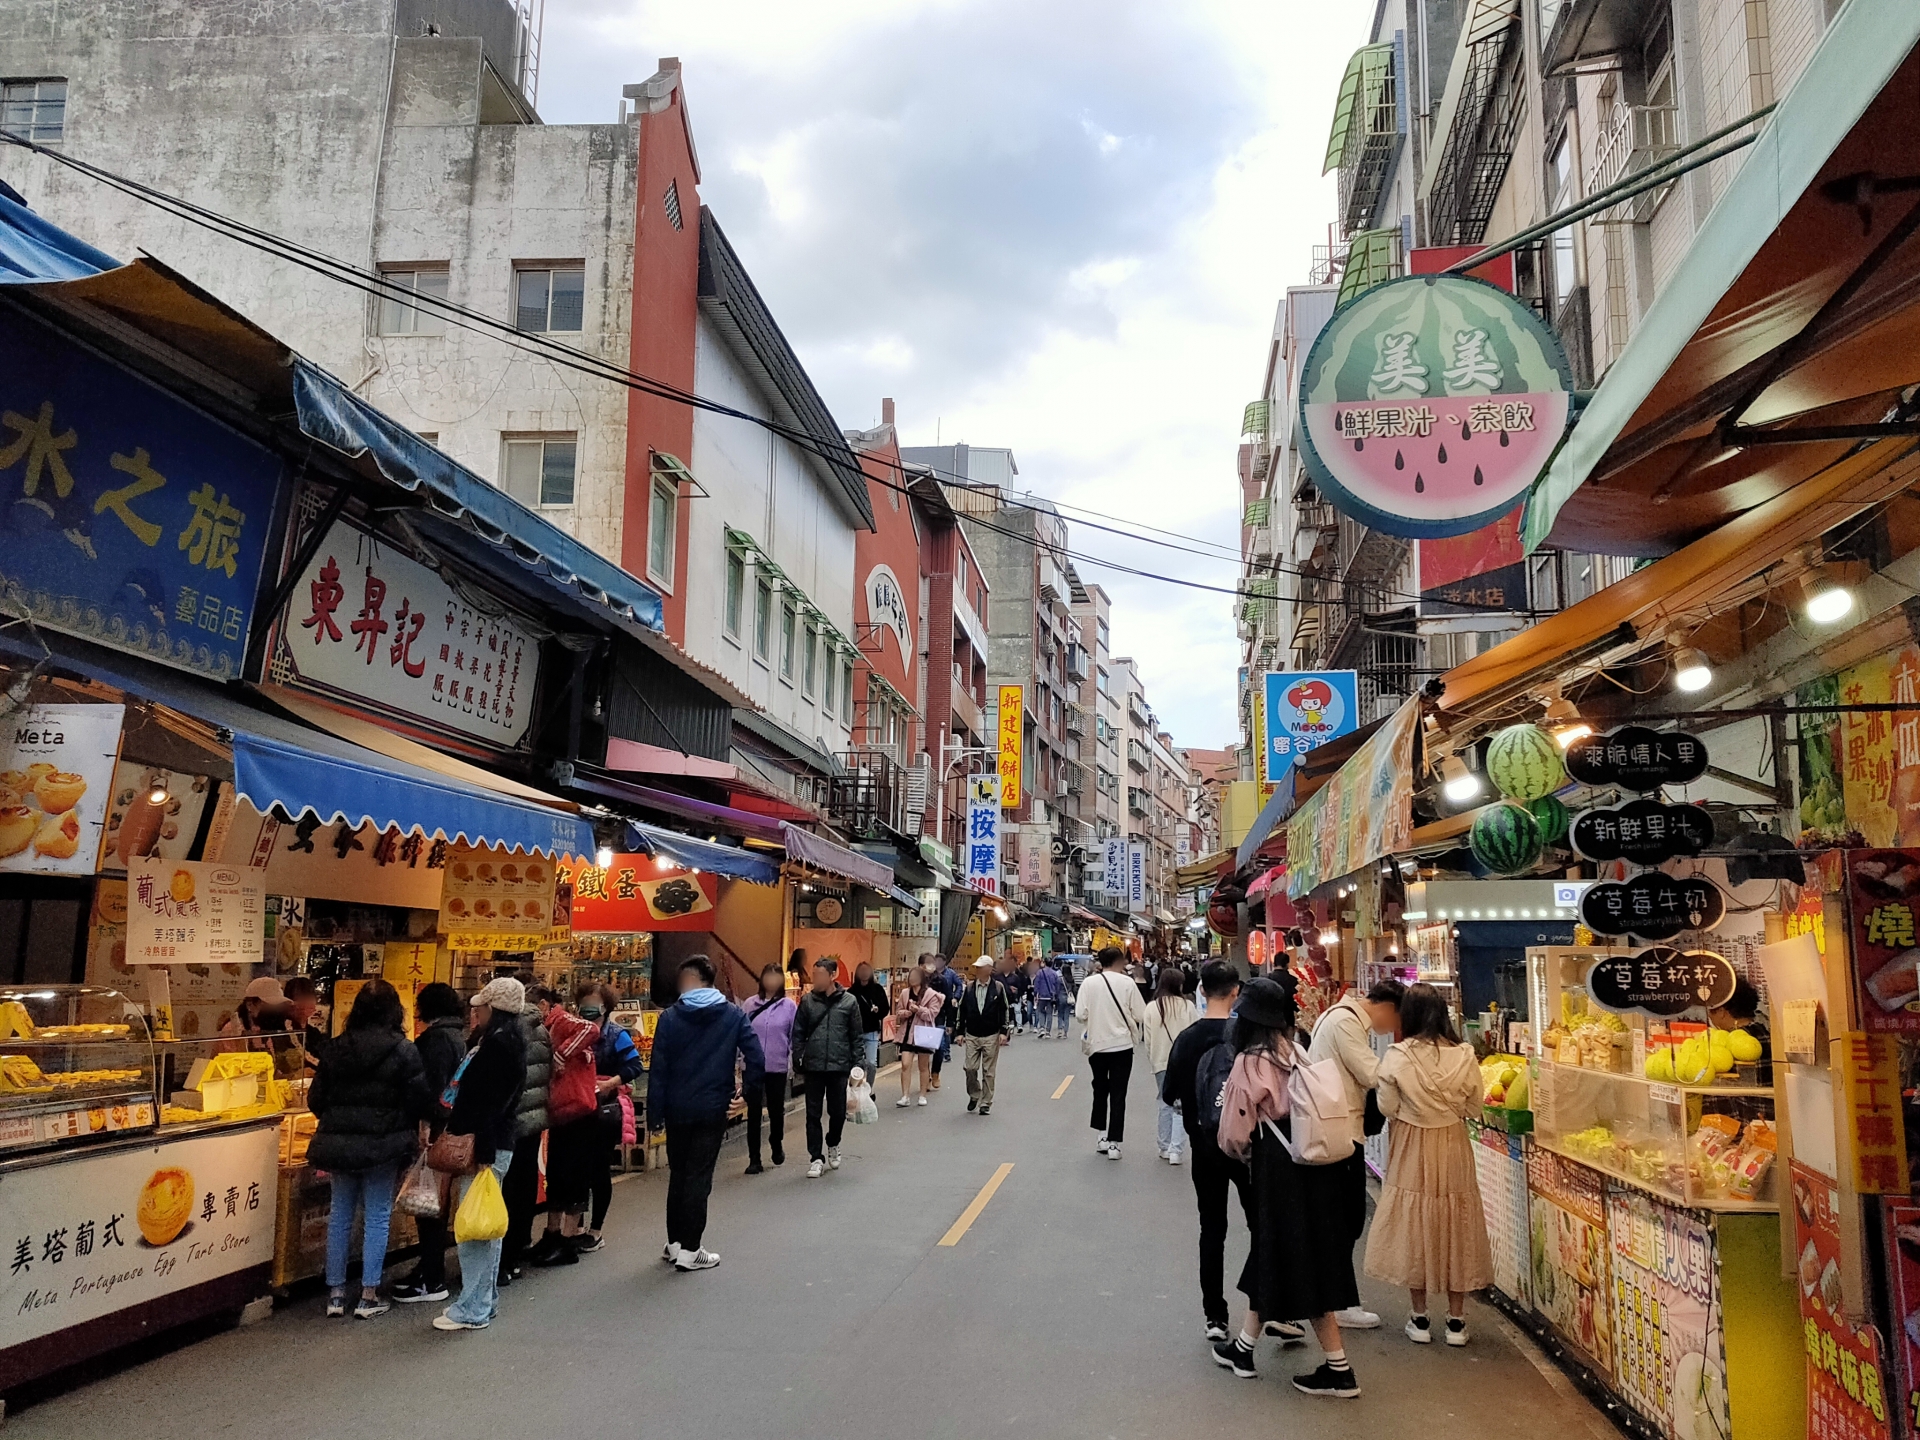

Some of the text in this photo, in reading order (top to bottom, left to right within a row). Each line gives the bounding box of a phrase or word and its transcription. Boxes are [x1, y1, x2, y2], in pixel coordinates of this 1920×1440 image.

[1371, 330, 1503, 394] 美美
[1341, 402, 1535, 438] 鮮果汁、茶飲
[0, 401, 246, 578] 水之旅
[175, 585, 243, 642] 藝品店
[302, 556, 427, 679] 東昇記
[1443, 587, 1504, 606] 淡水店
[14, 730, 65, 745] Meta
[1000, 692, 1020, 801] 新建成餅店
[1585, 742, 1695, 767] 爽脆情人果
[970, 809, 997, 875] 按摩
[1594, 814, 1691, 841] 新鮮果汁
[216, 873, 235, 882] MENU
[1131, 852, 1141, 901] BIRKENSTOCK
[1604, 888, 1708, 917] 草莓牛奶
[1863, 902, 1916, 948] 燒
[1614, 961, 1718, 991] 草莓杯杯
[1627, 991, 1691, 1002] strawberrycup
[10, 1181, 261, 1277] 美塔葡式 專賣店
[17, 1233, 251, 1316] Meta Portuguese Egg Tart Store
